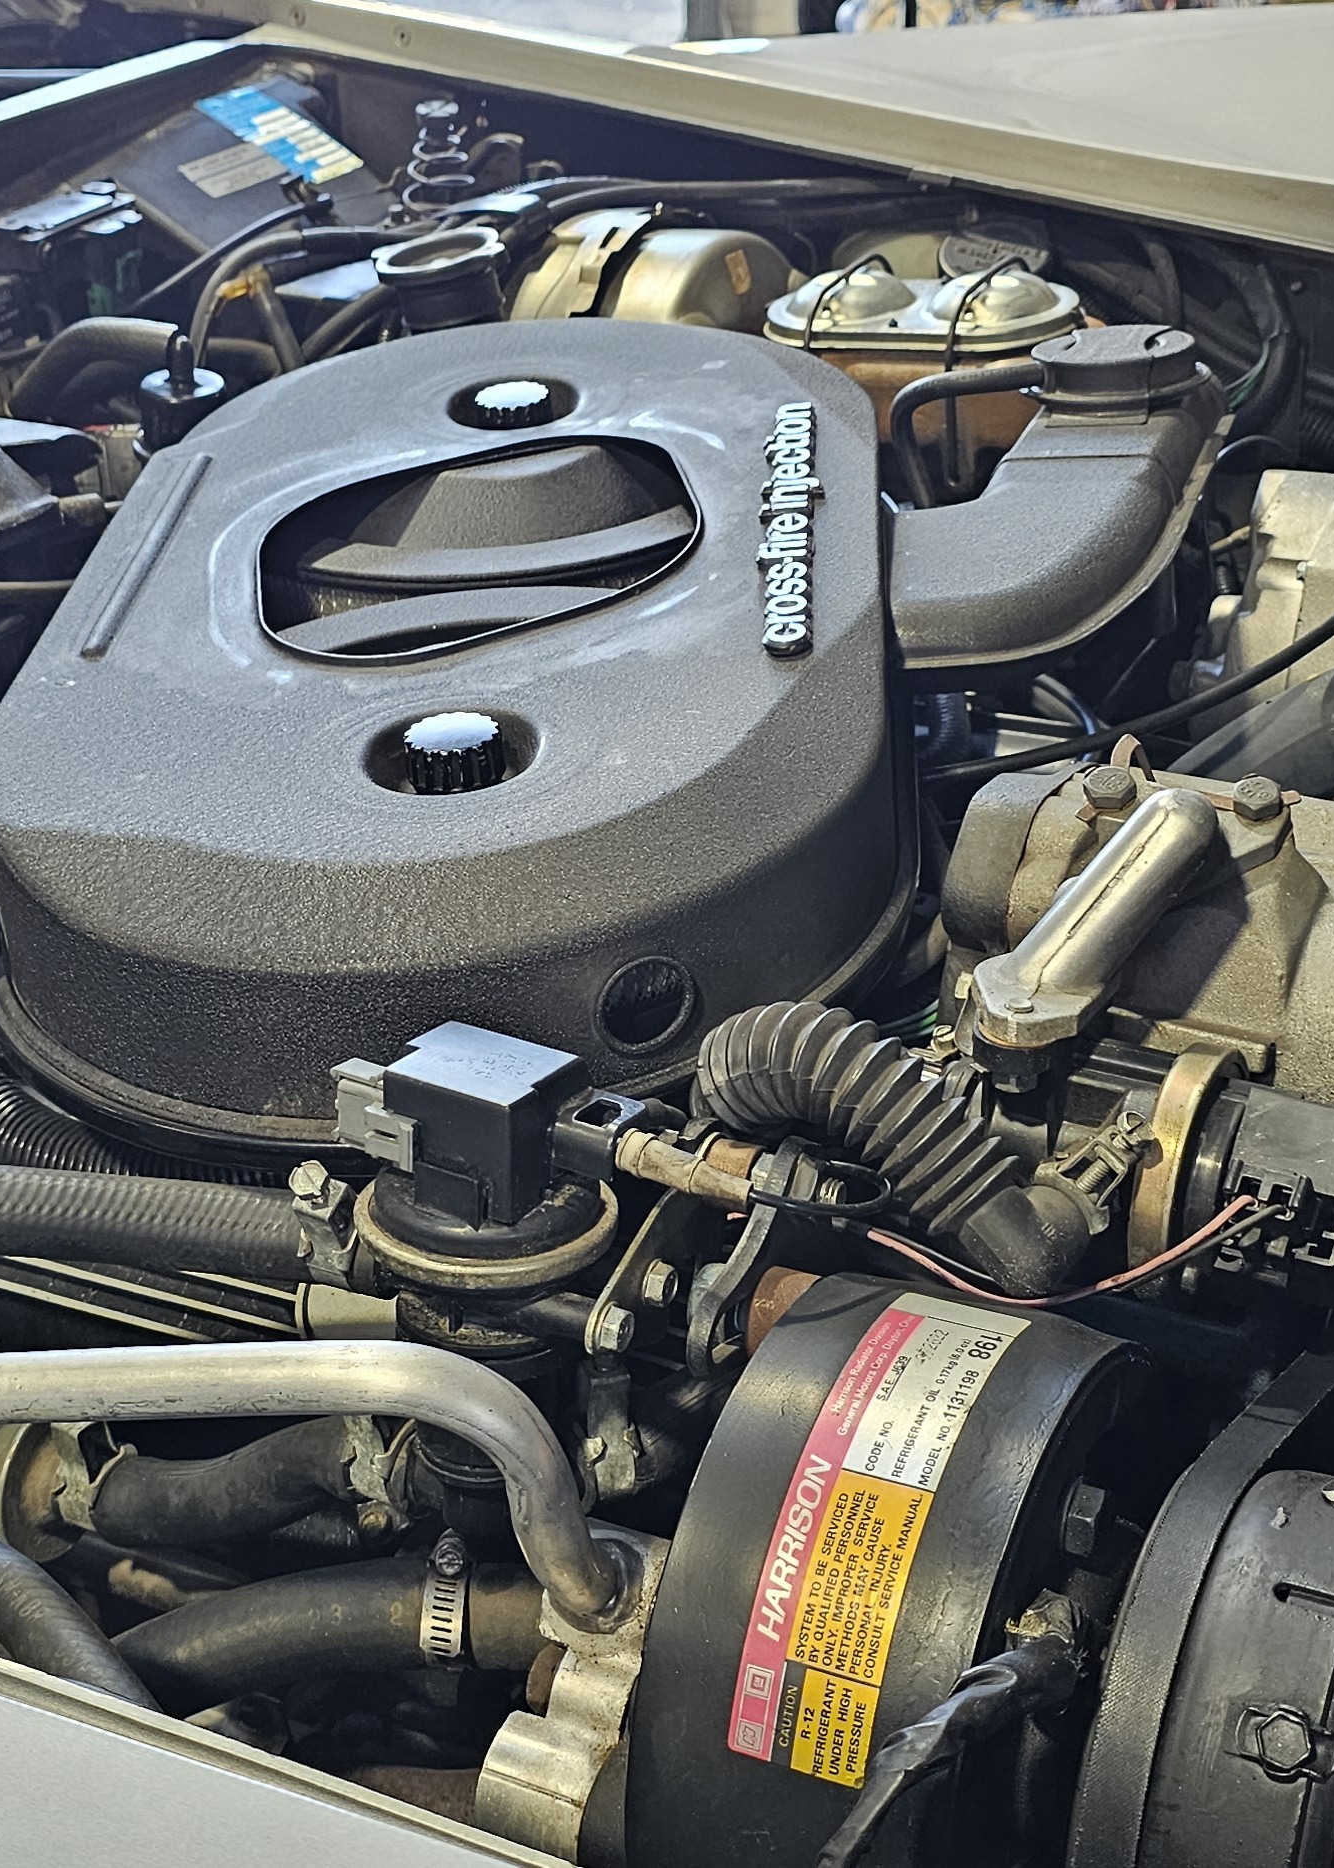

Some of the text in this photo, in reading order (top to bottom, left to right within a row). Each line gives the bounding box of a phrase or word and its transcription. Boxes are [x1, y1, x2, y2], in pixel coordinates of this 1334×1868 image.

[758, 401, 820, 643] cross-fire injection
[831, 1322, 891, 1412] Harrison Radiator Division
[891, 1355, 908, 1376] J639
[968, 1334, 1003, 1360] 198
[837, 1400, 861, 1436] General
[859, 1366, 876, 1400] Motors
[865, 1420, 894, 1471] CODE NO.
[891, 1405, 931, 1478] REFRIGERANT
[925, 1388, 940, 1402] OIL
[918, 1370, 980, 1486] MODEL NO. 1131198
[757, 1455, 832, 1642] HARRISON
[795, 1493, 848, 1658] SYSTEM TO BE SERVICED
[809, 1490, 865, 1663] BY QUALIFIED PERSONNEL
[822, 1493, 879, 1666] ONLY. IMPROPER SERVICE
[835, 1518, 884, 1671] METHODS MAY CAUSE
[863, 1494, 923, 1678] CONSULT SERVICE MANUAL.
[849, 1544, 891, 1675] PERSONAL INJURY.
[778, 1685, 798, 1747] CAUTION
[801, 1707, 814, 1739] R-12
[812, 1679, 836, 1774] REFRIGERANT
[829, 1688, 852, 1775] UNDER HIGH
[846, 1702, 866, 1772] PRESSURE
